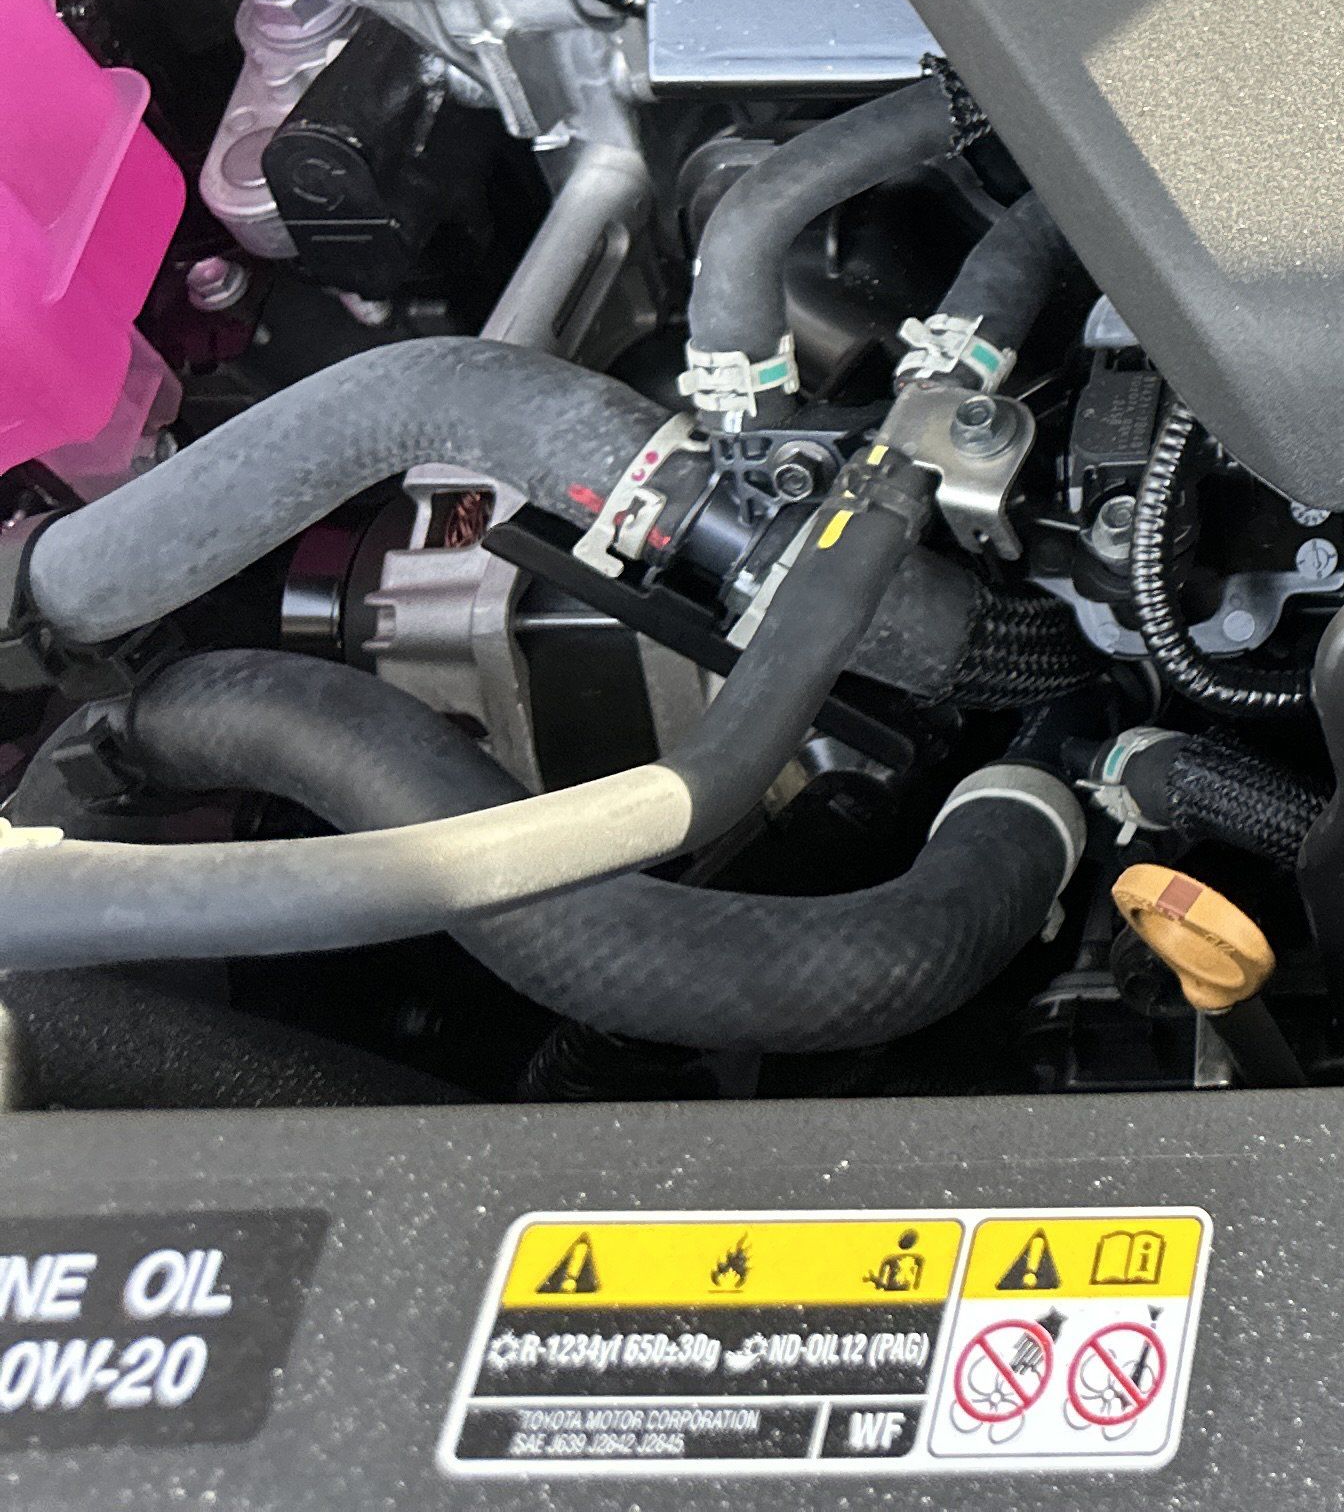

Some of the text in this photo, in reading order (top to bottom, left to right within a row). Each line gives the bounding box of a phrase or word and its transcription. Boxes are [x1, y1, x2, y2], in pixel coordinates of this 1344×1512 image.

[123, 1248, 233, 1321] OIL
[520, 1334, 622, 1370] R-1234yf
[868, 1331, 930, 1367] (PAG)
[0, 1335, 209, 1413] 0W-20
[520, 1409, 761, 1431] TOYOTA MOTOR CORPORATION
[848, 1411, 906, 1450] WF
[511, 1433, 546, 1455] SAE
